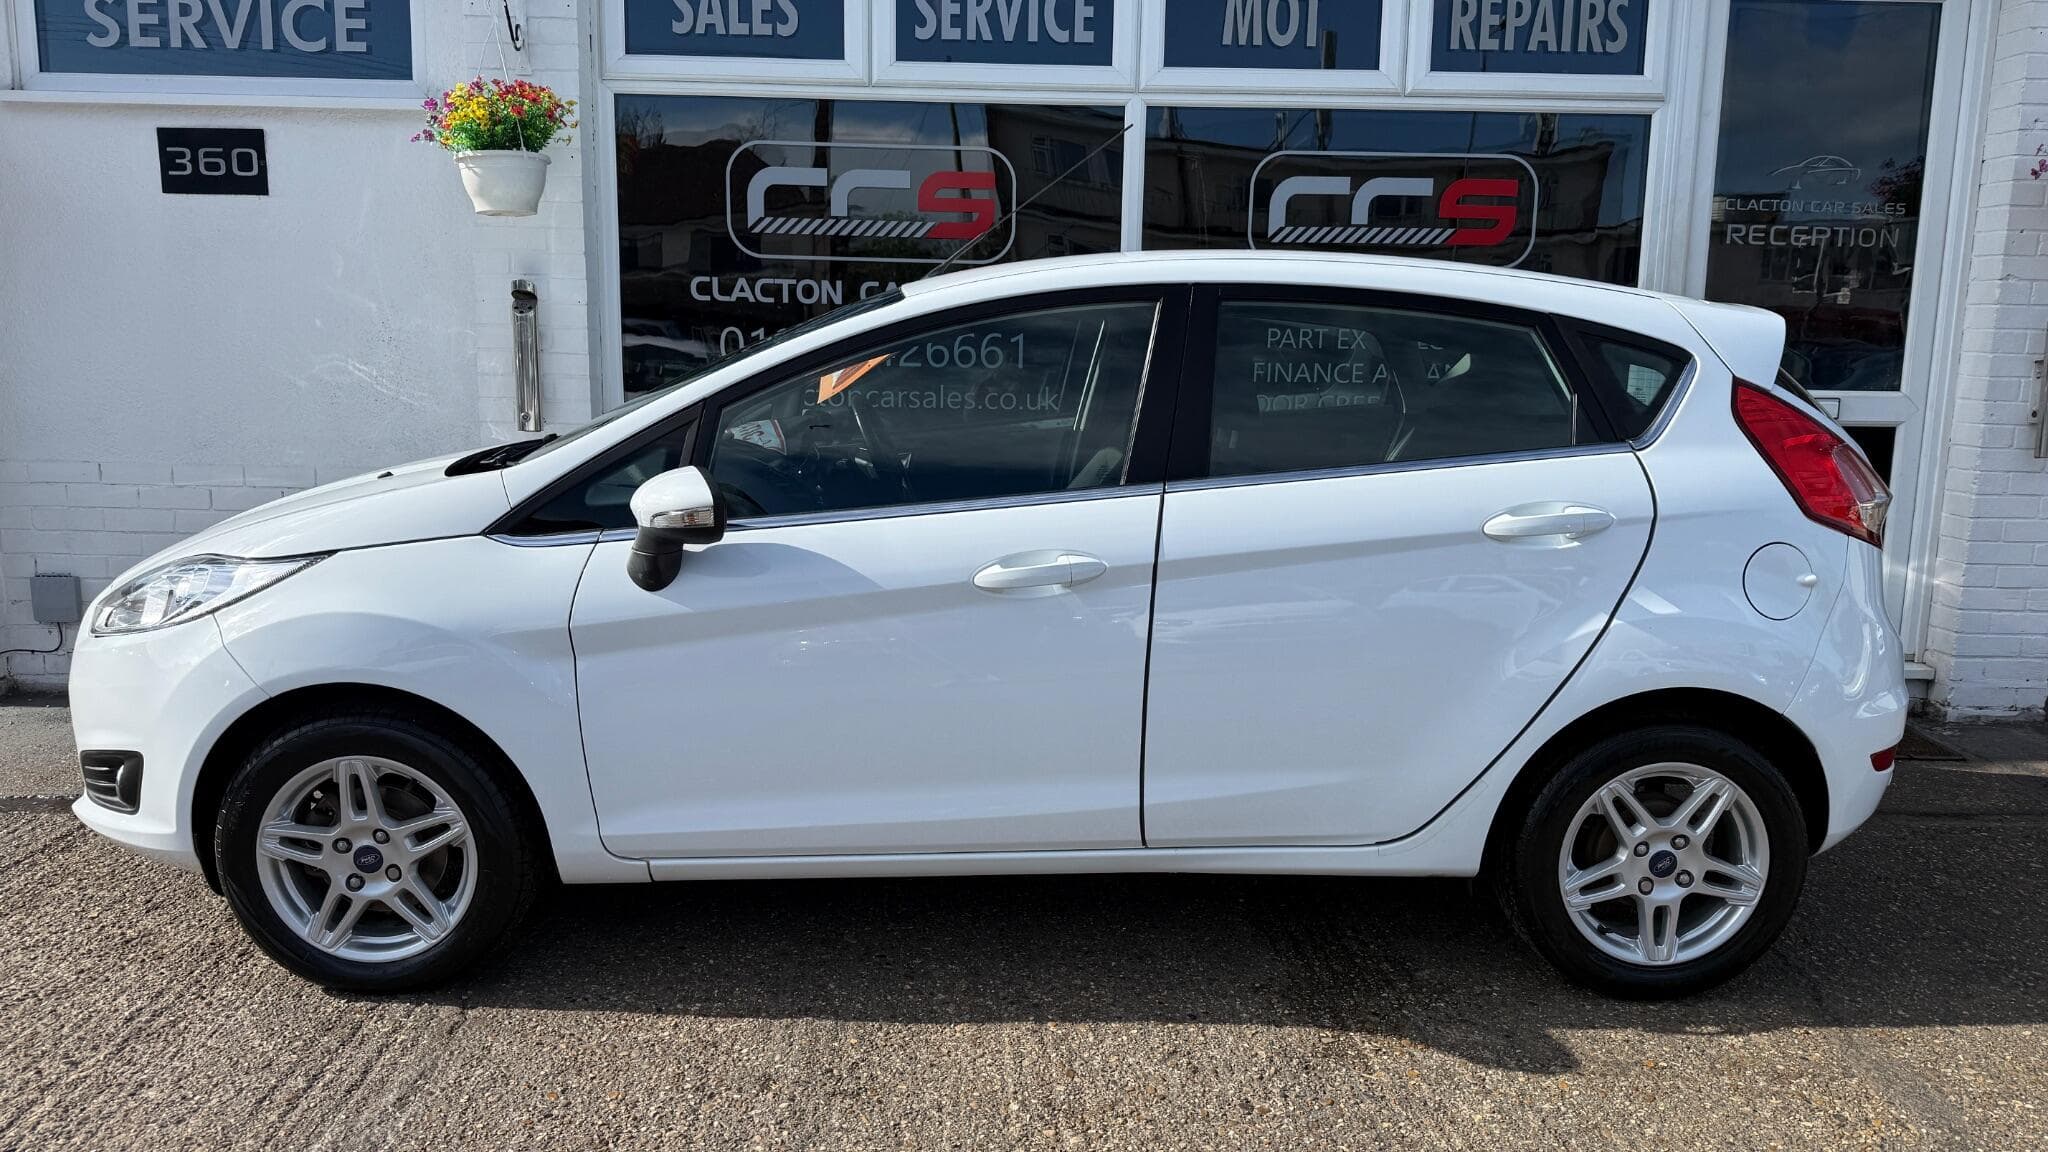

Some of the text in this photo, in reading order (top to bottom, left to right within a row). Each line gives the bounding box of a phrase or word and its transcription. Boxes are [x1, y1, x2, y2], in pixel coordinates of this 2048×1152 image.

[86, 0, 367, 52] SERVICE
[671, 0, 799, 37] SALES
[915, 0, 1095, 43] SERVICE
[1450, 0, 1629, 53] REPAIRS
[166, 147, 259, 176] 360
[1726, 199, 1907, 215] CLACTON CAR SALES
[1727, 225, 1899, 247] RECEPTION
[690, 276, 843, 305] CLACTON
[1267, 328, 1366, 350] PART EX
[1253, 361, 1364, 384] FINANCE
